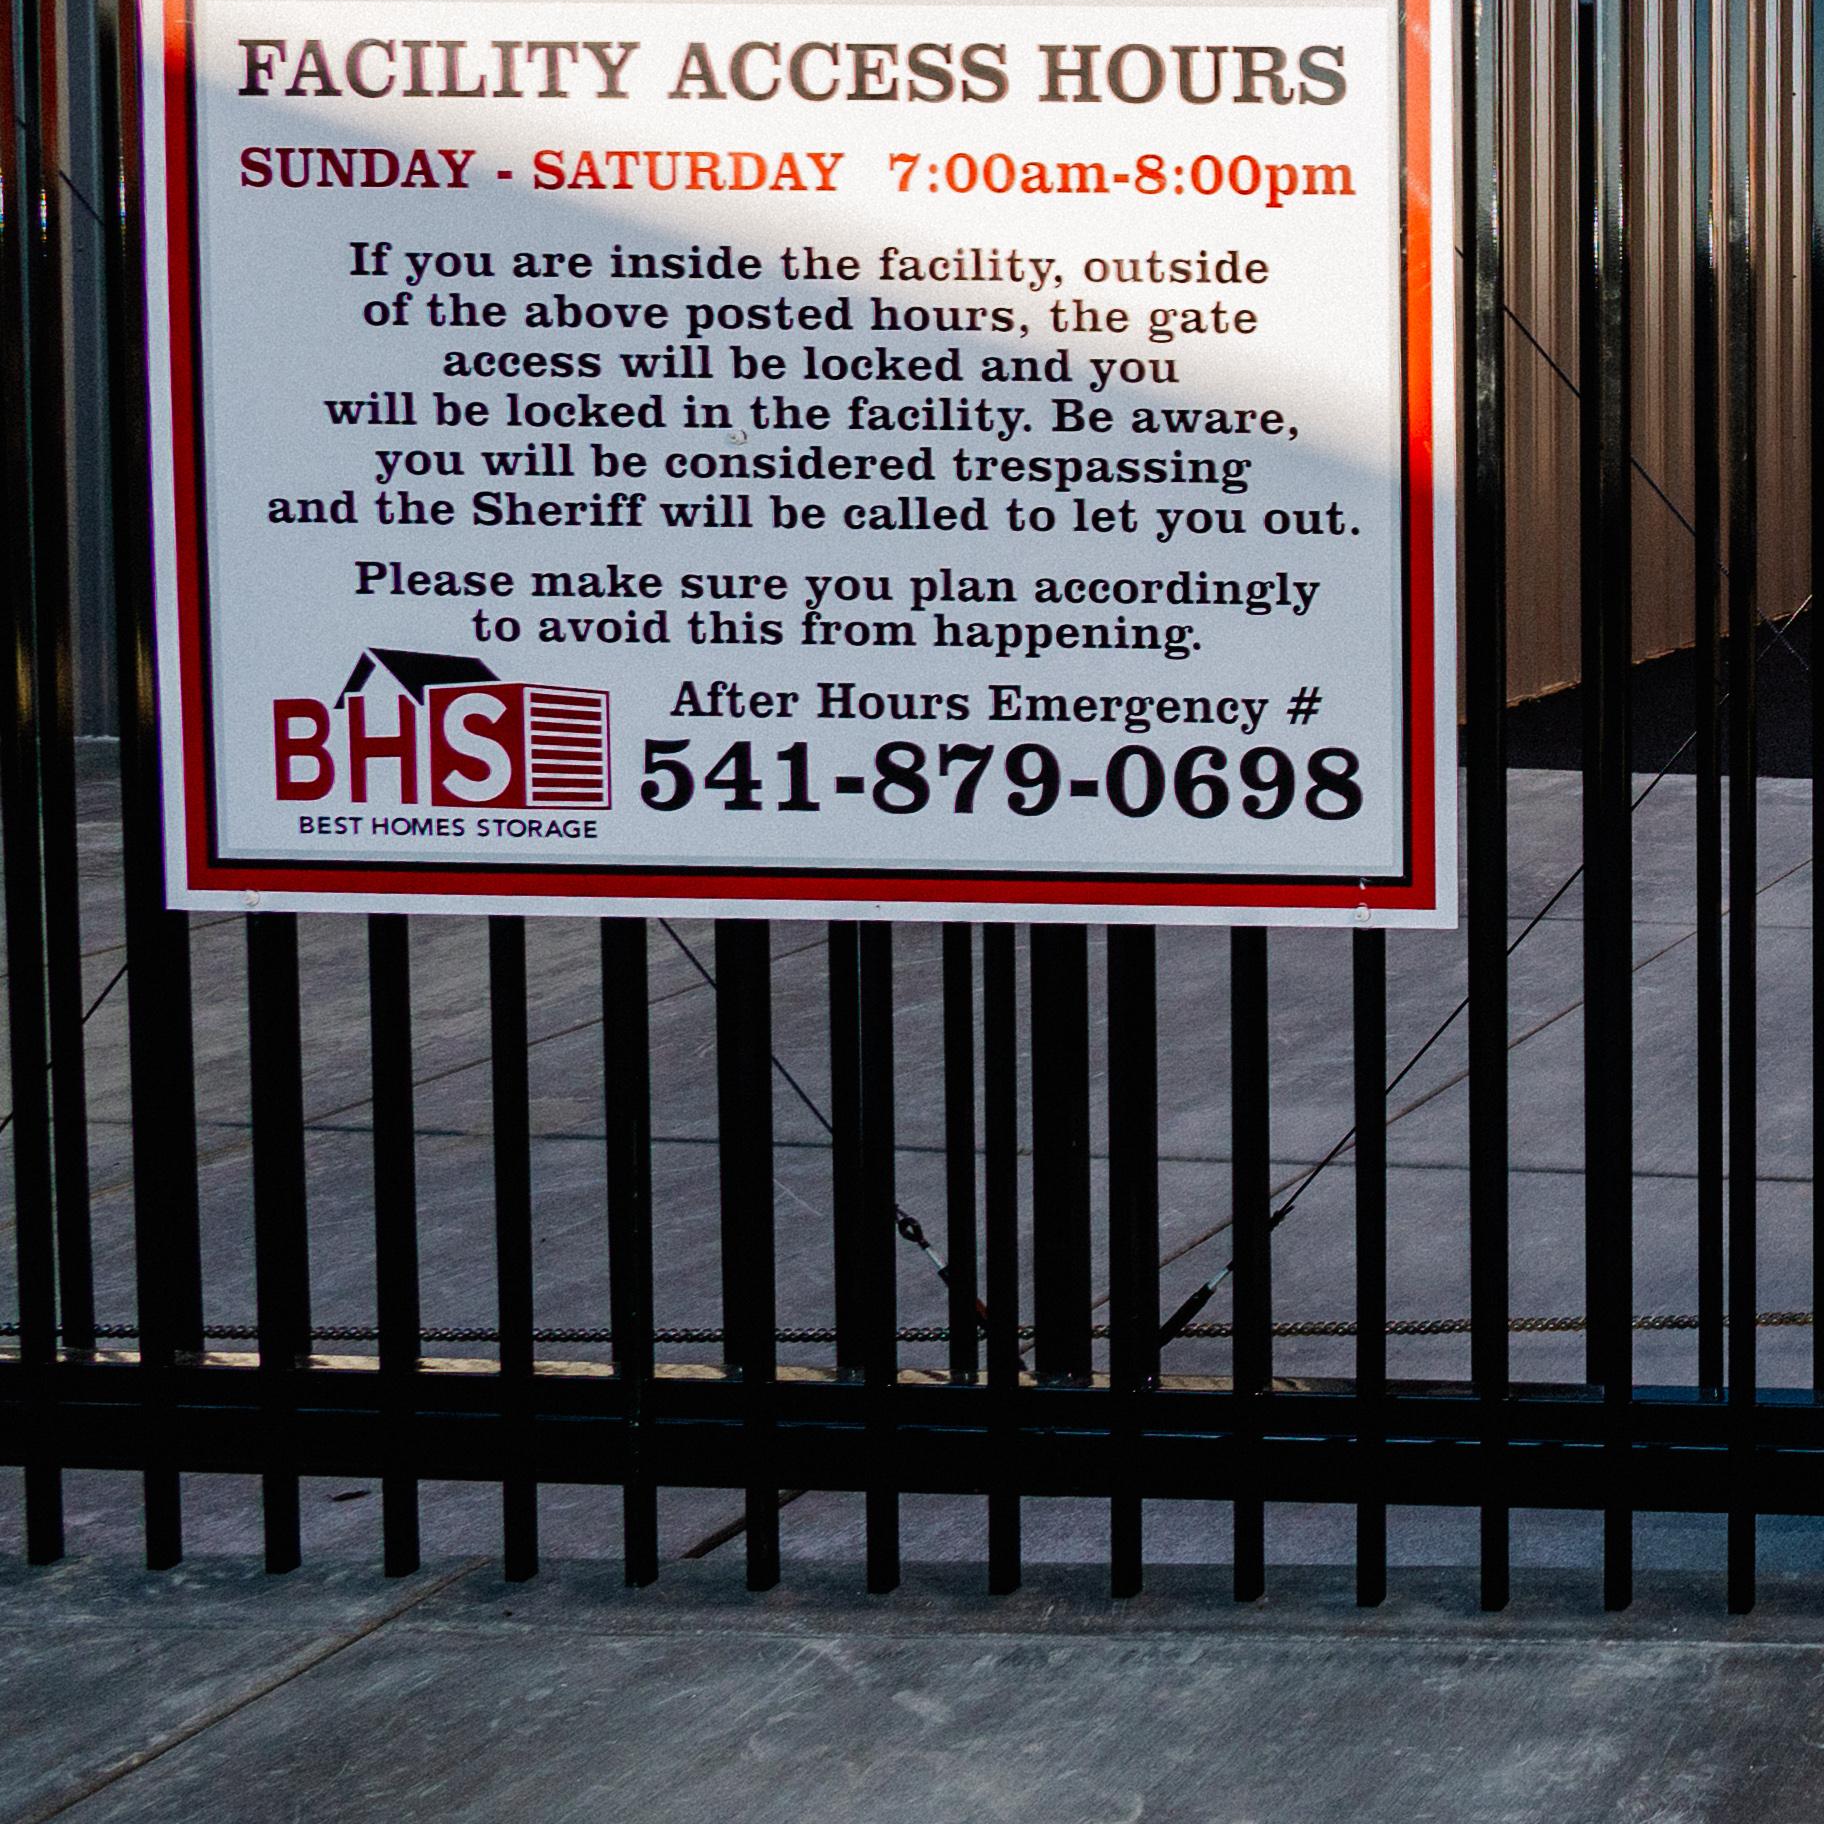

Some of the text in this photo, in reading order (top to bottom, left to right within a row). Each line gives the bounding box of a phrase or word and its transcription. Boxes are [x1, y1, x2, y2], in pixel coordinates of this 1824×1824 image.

[237, 38, 1347, 106] FACILITY ACCESS HOURS
[239, 146, 1357, 209] SUNDAY - SATURDAY 7:00am-8:00pm
[348, 241, 1270, 293] If you are inside the facility, outside
[362, 290, 1258, 344] of the above posted hours, the gate
[442, 344, 1180, 394] access will be locked and you
[323, 390, 1299, 443] will be locked in the facility. Be aware,
[374, 442, 1253, 495] you will be considered trespassing
[267, 489, 1361, 544] and the Sheriff will be called to let you out.
[354, 560, 1321, 617] Please make sure you plan accordingly
[471, 608, 1202, 661] to avoid this from happening.
[669, 679, 1324, 736] After Hours Emergency #
[272, 691, 513, 806] BHS
[639, 738, 1364, 821] 541-879-0698
[298, 815, 598, 839] BEST HOMES STORAGE
